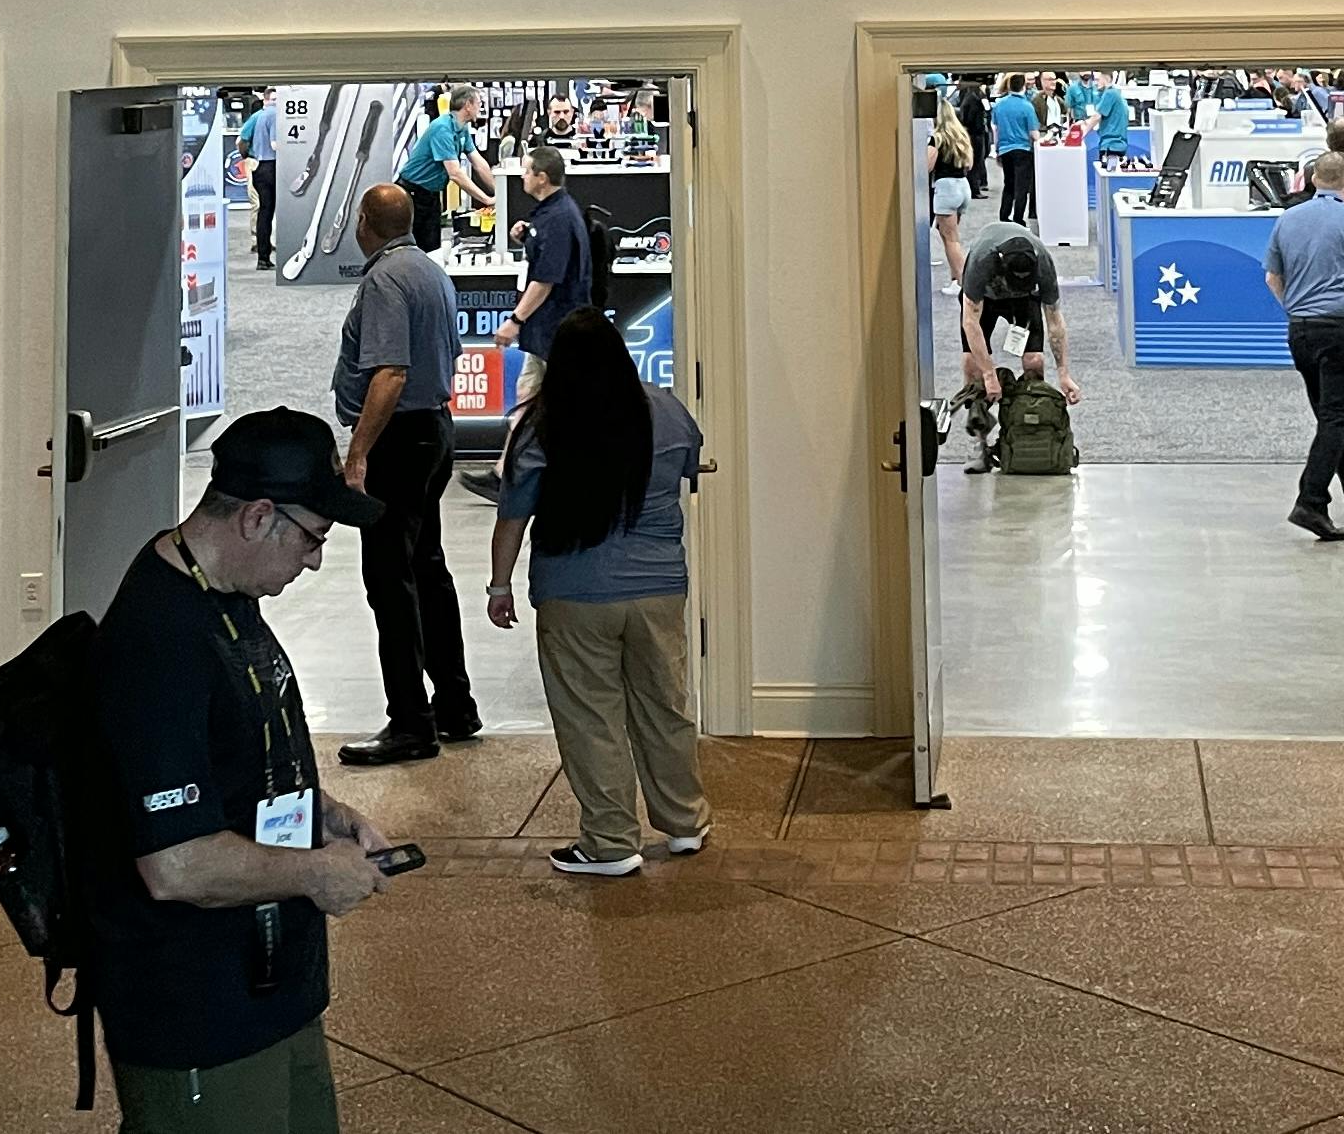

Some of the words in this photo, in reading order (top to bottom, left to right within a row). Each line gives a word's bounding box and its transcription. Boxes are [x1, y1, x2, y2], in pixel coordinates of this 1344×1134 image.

[285, 100, 308, 115] 88
[457, 353, 485, 373] GO
[454, 373, 488, 394] BIG
[457, 394, 486, 409] AND
